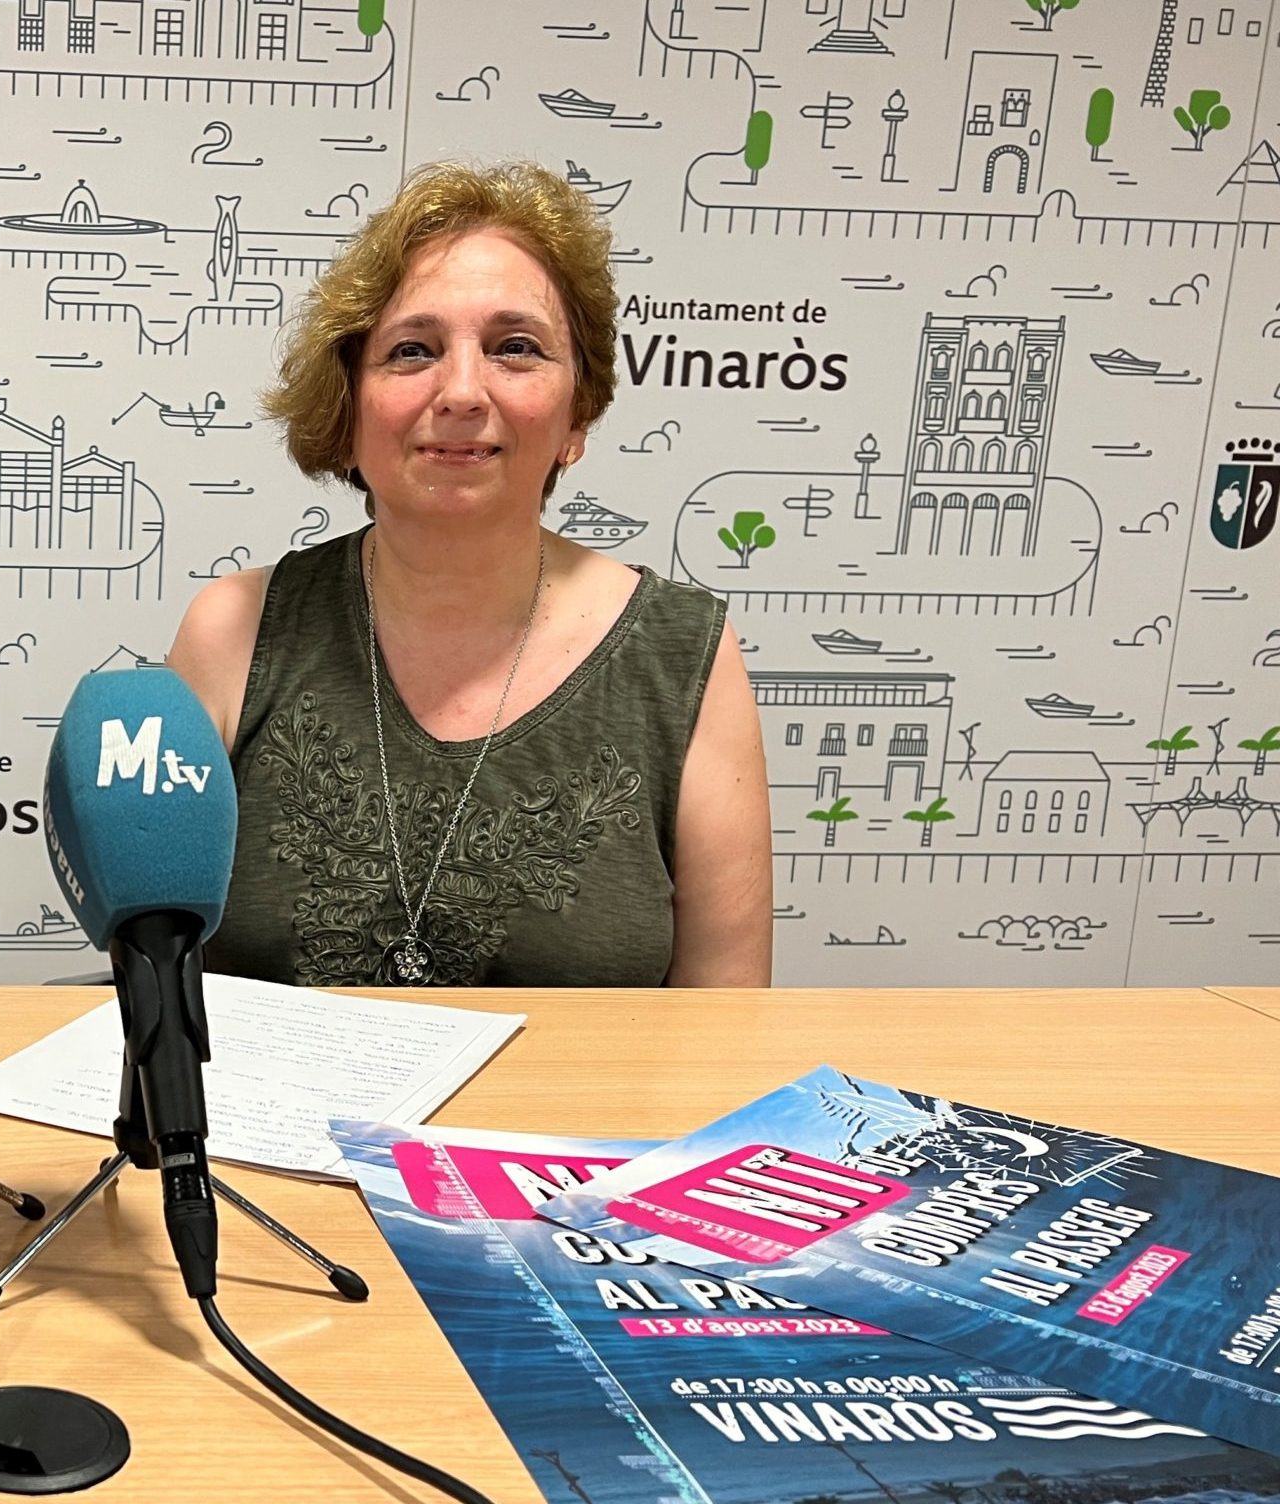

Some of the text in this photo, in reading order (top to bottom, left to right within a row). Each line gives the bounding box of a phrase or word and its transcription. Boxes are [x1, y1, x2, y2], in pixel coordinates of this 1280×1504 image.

[623, 295, 827, 325] Ajuntament de
[621, 334, 848, 391] Vinaròs
[683, 1147, 889, 1232] NIT
[858, 1146, 926, 1177] DE
[980, 1198, 1153, 1307] AL PASSEIG
[595, 1279, 679, 1310] AL
[1087, 1300, 1124, 1317] 13
[1132, 1251, 1178, 1277] 2023
[639, 1318, 861, 1337] 13 d'agost 2023
[1219, 1347, 1258, 1365] de
[670, 1374, 960, 1395] de 17:00 h a 00:00 h
[690, 1391, 997, 1442] VINARÒS
